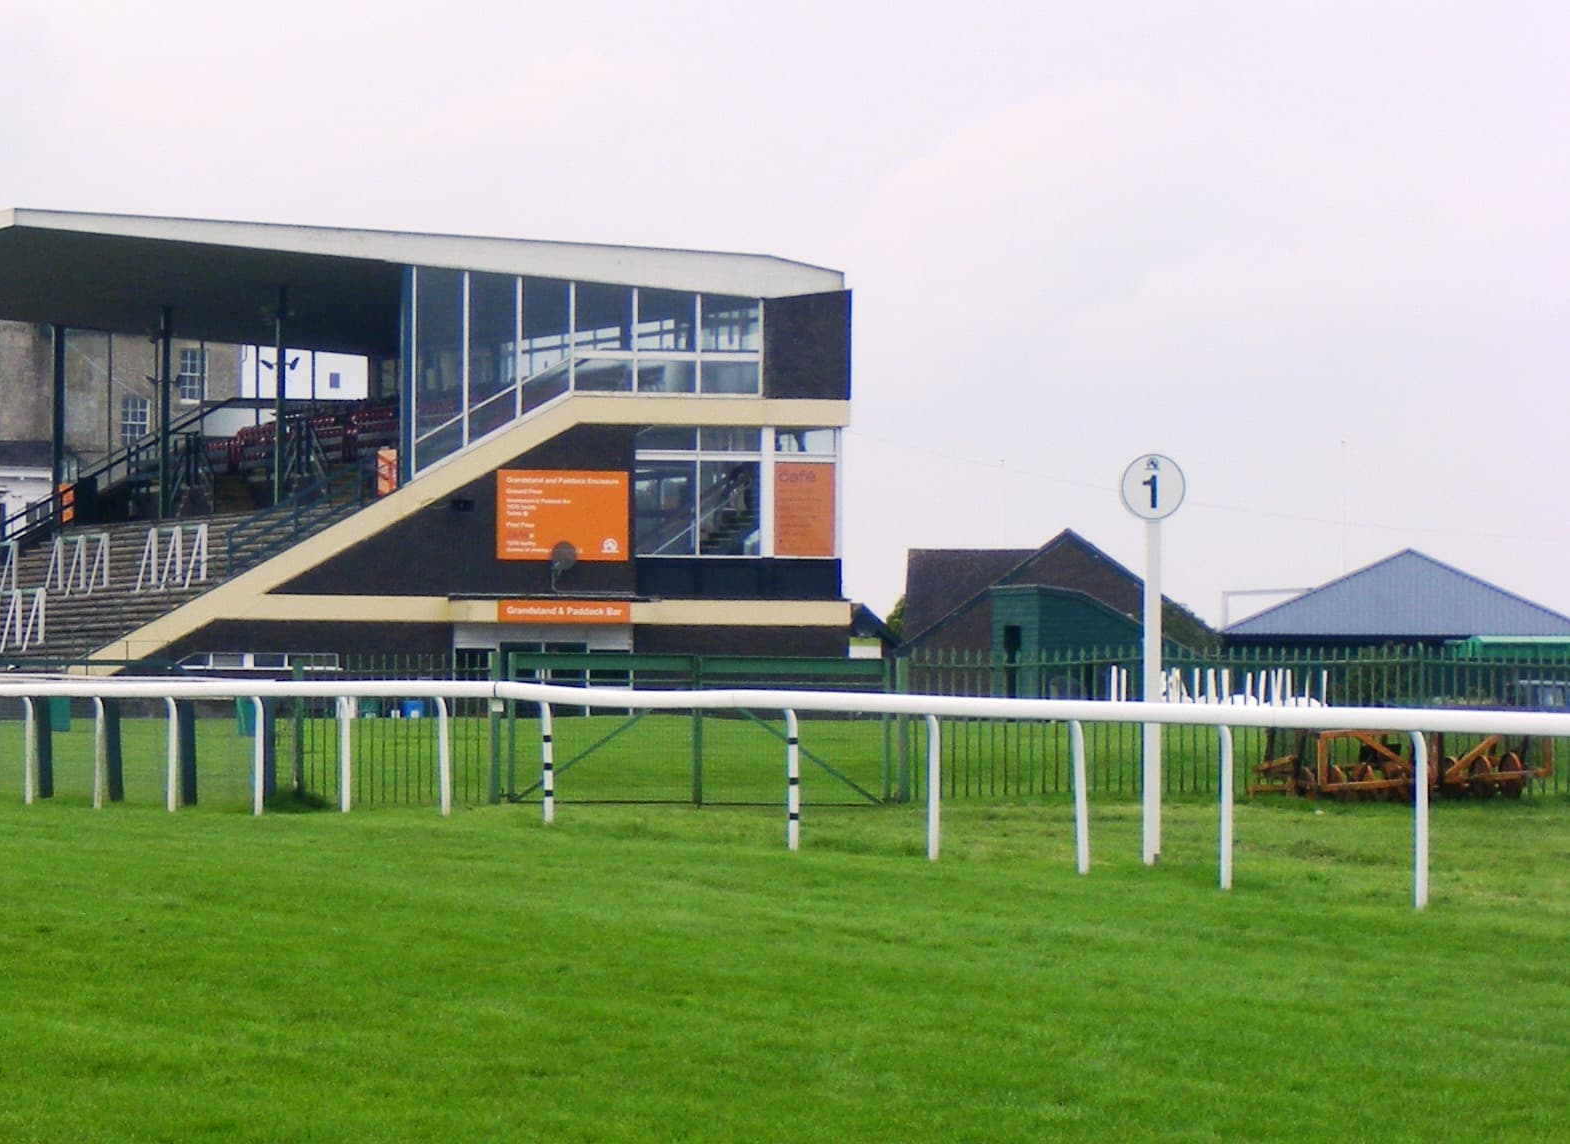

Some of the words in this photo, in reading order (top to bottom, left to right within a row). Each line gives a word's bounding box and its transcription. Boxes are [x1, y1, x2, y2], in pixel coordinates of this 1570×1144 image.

[506, 476, 544, 484] Grandstand
[545, 477, 557, 485] and
[558, 477, 586, 486] Paddock
[1142, 474, 1158, 509] 1
[506, 606, 557, 616] Grandstand
[558, 606, 565, 616] &
[566, 606, 604, 617] Paddock
[605, 606, 623, 617] Bar
